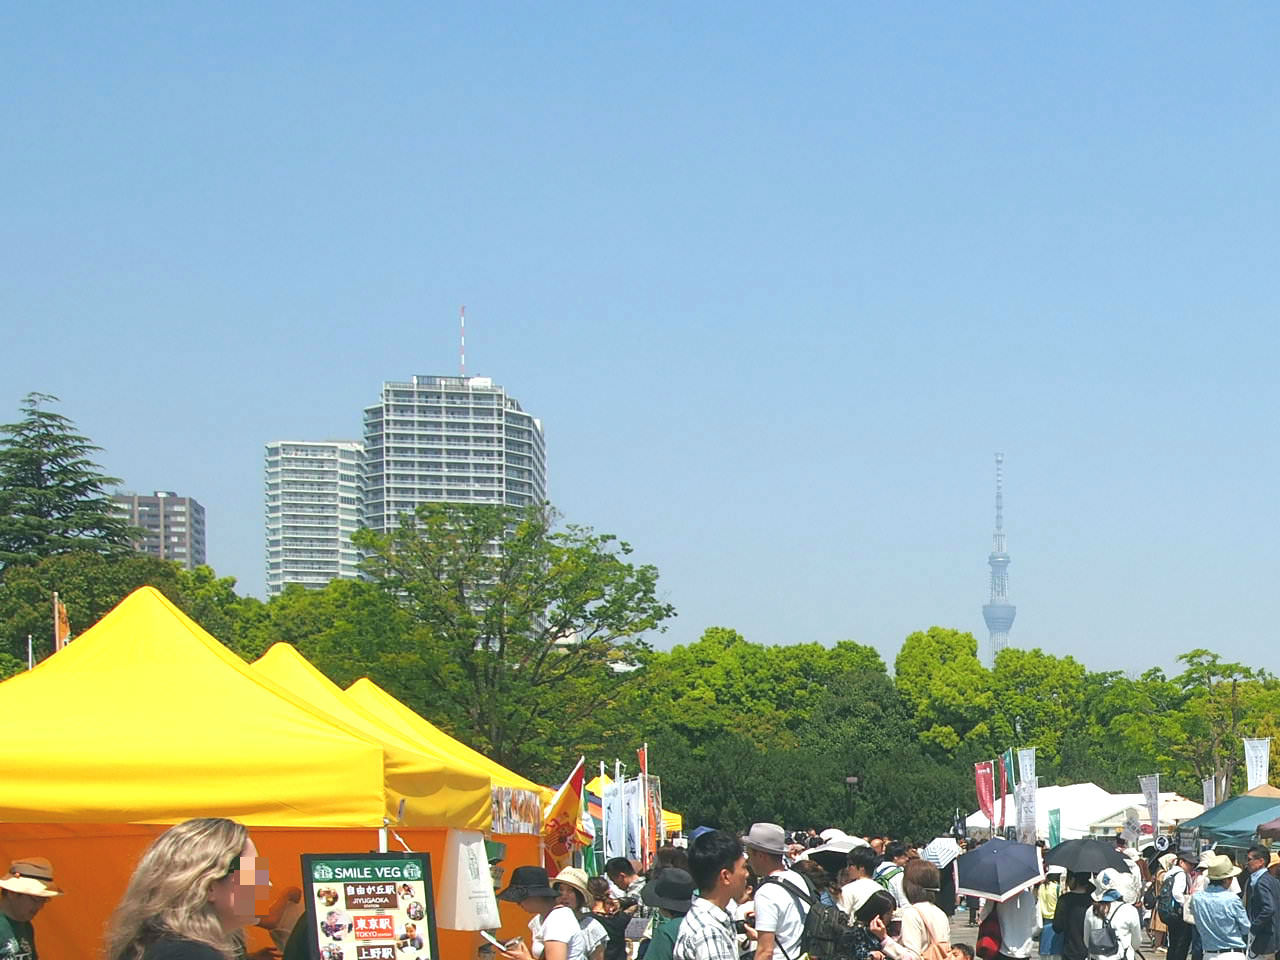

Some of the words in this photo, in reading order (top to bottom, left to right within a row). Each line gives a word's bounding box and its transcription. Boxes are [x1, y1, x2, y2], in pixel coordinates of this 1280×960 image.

[334, 867, 372, 879] SMILE
[375, 867, 401, 878] VEG
[346, 885, 396, 896] 自由が丘駅
[352, 897, 390, 905] JIYUGAOKA
[355, 918, 392, 930] 東京駅
[358, 947, 395, 960] 上野駅
